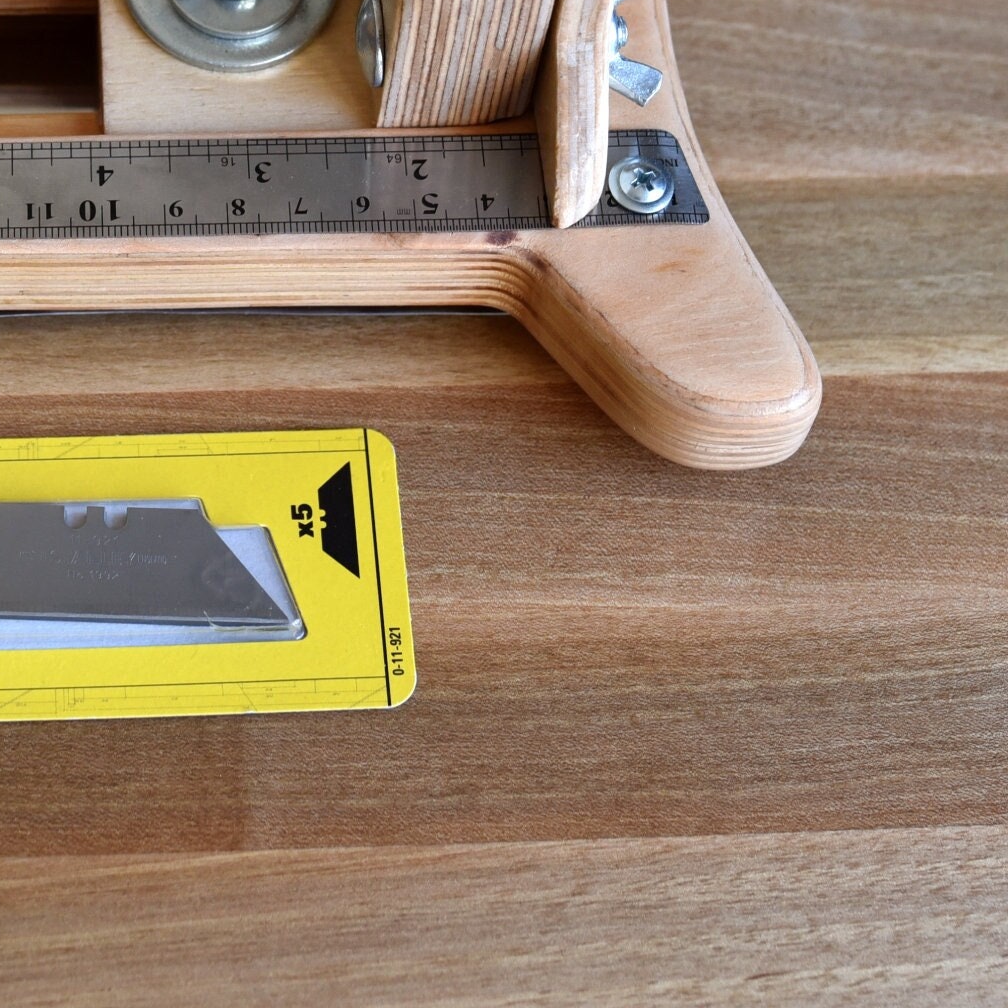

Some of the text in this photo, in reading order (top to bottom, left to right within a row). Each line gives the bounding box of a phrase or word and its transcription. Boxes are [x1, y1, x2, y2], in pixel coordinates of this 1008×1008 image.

[220, 156, 237, 167] 16
[386, 153, 402, 164] 64
[96, 165, 114, 186] 4
[254, 161, 272, 183] 3
[411, 159, 429, 181] 2
[25, 202, 55, 220] 11
[78, 199, 122, 222] 10
[168, 198, 184, 218] 9
[231, 198, 246, 216] 8
[294, 197, 308, 215] 7
[356, 196, 370, 214] 6
[396, 208, 411, 216] mm
[421, 193, 439, 215] 5
[480, 194, 495, 211] 4
[290, 503, 315, 538] x5
[389, 627, 404, 676] 0-11-921
